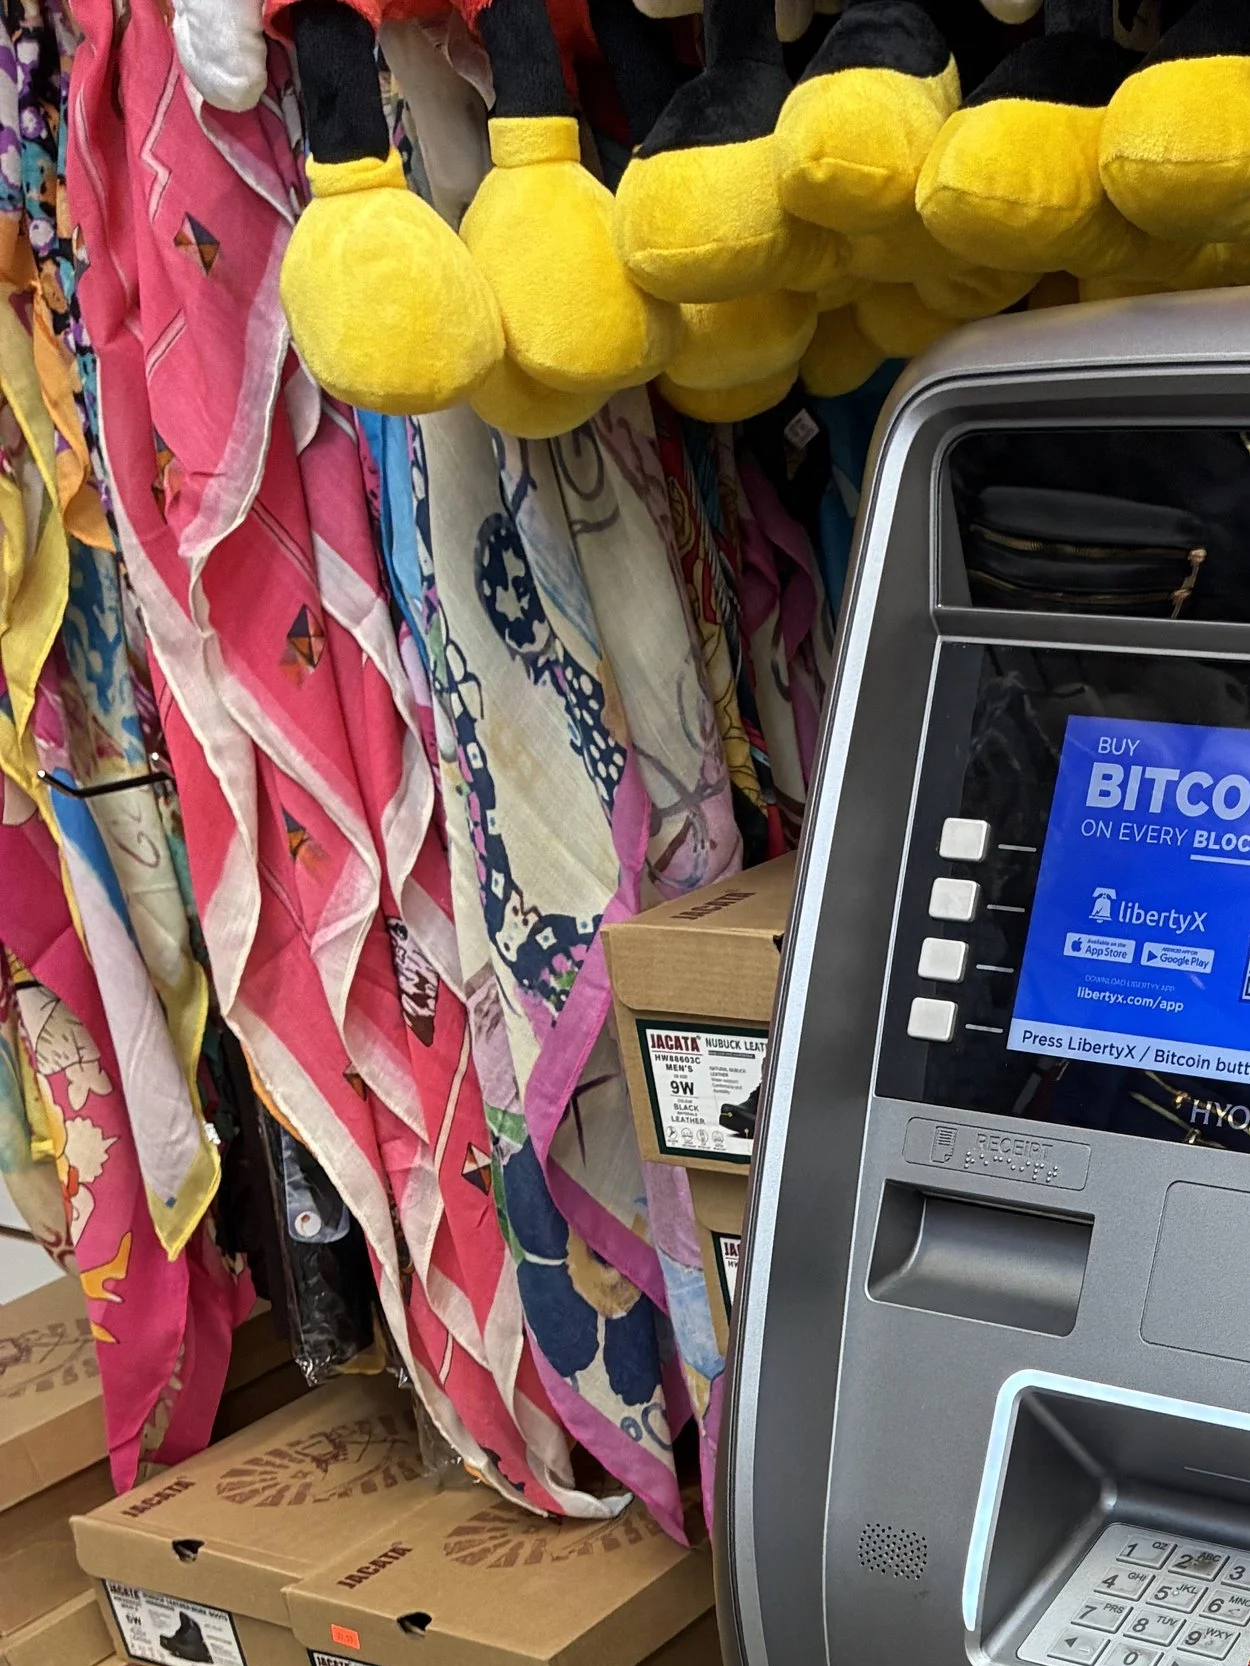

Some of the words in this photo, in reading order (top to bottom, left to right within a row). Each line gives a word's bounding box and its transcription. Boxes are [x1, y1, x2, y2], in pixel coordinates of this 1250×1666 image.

[1098, 737, 1140, 756] BUY
[1081, 819, 1113, 838] ON
[1119, 822, 1188, 846] EVERY
[669, 892, 756, 920] JACATA
[1118, 901, 1208, 934] libertyX
[1085, 945, 1104, 957] App
[1104, 947, 1128, 959] Store
[1160, 953, 1189, 967] Google
[1190, 957, 1210, 970] Play
[1085, 974, 1126, 986] DOWNLOAD
[1077, 987, 1184, 1013] libertyx.com/app
[650, 1033, 700, 1053] JACATA
[705, 1037, 741, 1050] NUBUCK
[744, 1041, 766, 1052] LEAT
[1022, 1030, 1063, 1049] Press
[1068, 1036, 1135, 1060] LibertyX
[1154, 1049, 1210, 1070] Bitcoin
[665, 1063, 694, 1073] MEN'S
[670, 1080, 694, 1096] 9W
[674, 1103, 699, 1112] BLACK
[671, 1115, 706, 1126] LEATHER
[977, 1133, 1053, 1157] RECEIPT
[337, 1547, 413, 1589] JACATA
[1125, 1543, 1138, 1557] 1
[1152, 1541, 1169, 1551] QZ
[1175, 1553, 1190, 1570] 2
[1199, 1551, 1222, 1563] ABC
[1229, 1566, 1244, 1581] 3
[1101, 1574, 1116, 1589] 4
[1128, 1571, 1147, 1582] GHI
[1154, 1585, 1169, 1600] 5
[1176, 1583, 1198, 1595] JKL
[1207, 1598, 1222, 1614] 6
[1079, 1604, 1098, 1619] 7
[1103, 1603, 1125, 1614] PRS
[1132, 1618, 1147, 1633] 8
[1156, 1614, 1179, 1627] TUV
[1184, 1629, 1202, 1646] 9
[1205, 1628, 1233, 1640] WXY
[1122, 1650, 1139, 1666] 0
